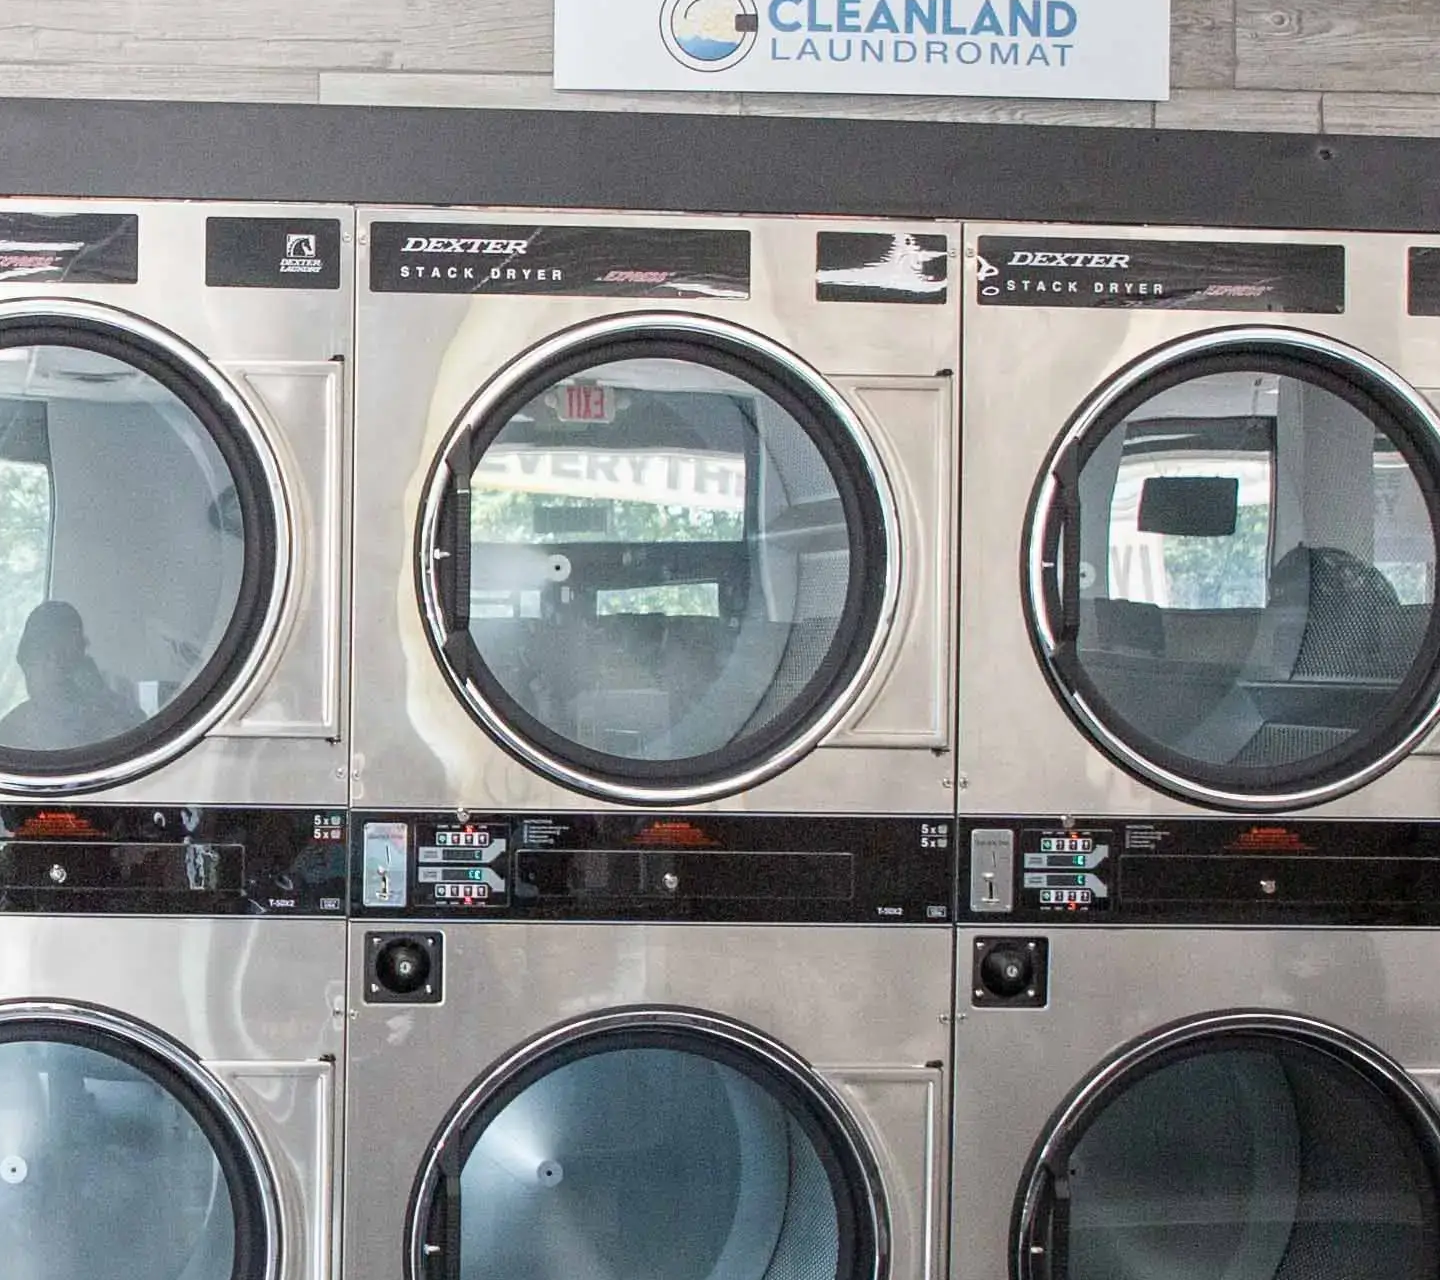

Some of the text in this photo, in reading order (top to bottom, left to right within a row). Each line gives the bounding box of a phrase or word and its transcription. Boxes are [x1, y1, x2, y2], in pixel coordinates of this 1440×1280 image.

[771, 39, 1074, 66] LAUNDROMAT
[401, 238, 528, 254] DEXTER
[280, 258, 321, 267] DEXTER
[1008, 252, 1130, 269] DEXTER
[400, 267, 563, 280] STACK DRYER
[1007, 281, 1164, 295] STACK DRYER
[314, 815, 321, 825] 5
[314, 829, 321, 839] 5
[921, 824, 928, 834] 5
[921, 838, 928, 847] 5
